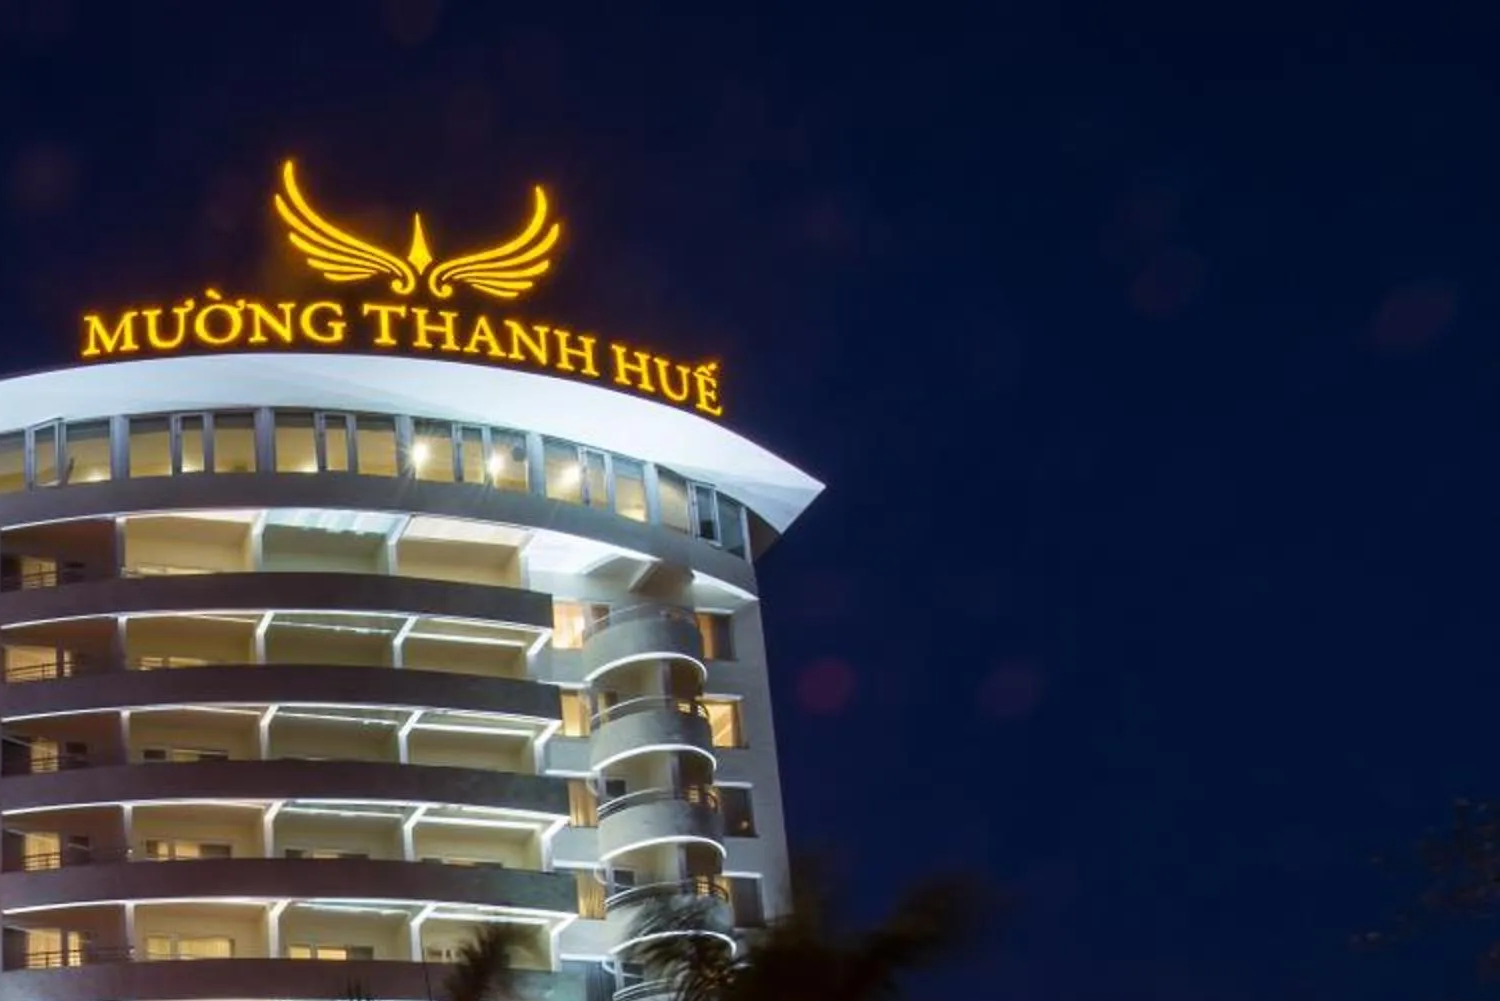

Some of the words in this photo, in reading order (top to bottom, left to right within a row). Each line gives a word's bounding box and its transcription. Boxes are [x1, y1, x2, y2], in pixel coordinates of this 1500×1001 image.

[81, 287, 347, 357] MƯỜNG
[362, 302, 600, 378] THANH
[610, 342, 723, 417] HUẾ
